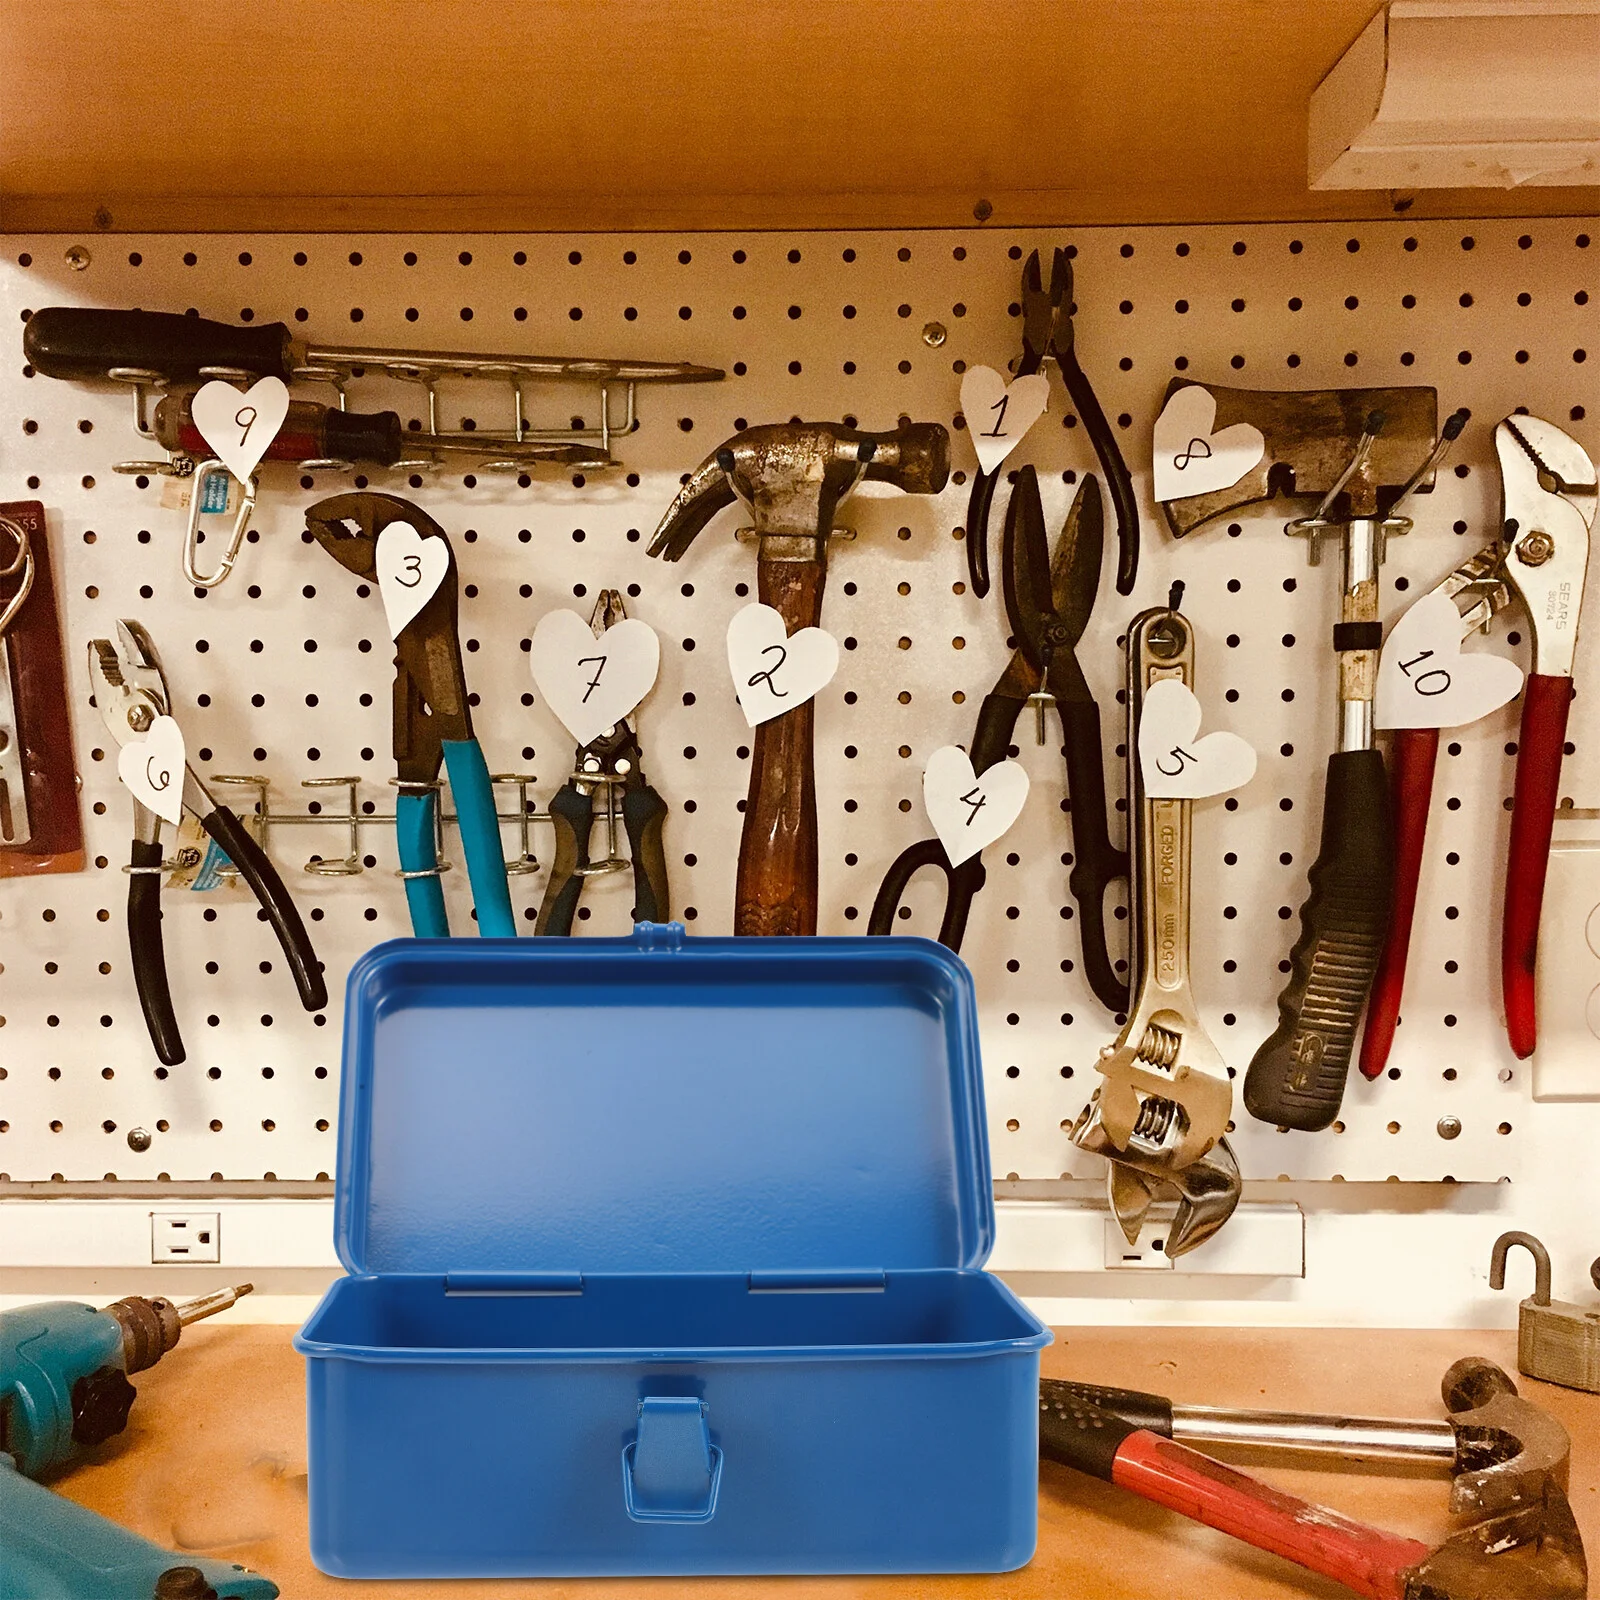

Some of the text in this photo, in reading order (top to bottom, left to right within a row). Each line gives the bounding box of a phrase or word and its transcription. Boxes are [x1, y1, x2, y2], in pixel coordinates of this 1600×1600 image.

[235, 407, 257, 447] 9
[981, 396, 1009, 438] 1
[1173, 438, 1213, 471] 8
[207, 483, 217, 509] Holder
[395, 556, 421, 588] 3
[1555, 582, 1571, 630] SEARS
[578, 656, 607, 703] 7
[748, 645, 788, 697] 2
[1398, 650, 1451, 697] 10
[147, 757, 170, 791] 6
[1155, 745, 1198, 776] 5
[960, 787, 986, 826] 4
[1161, 825, 1175, 971] 250mm FORGED
